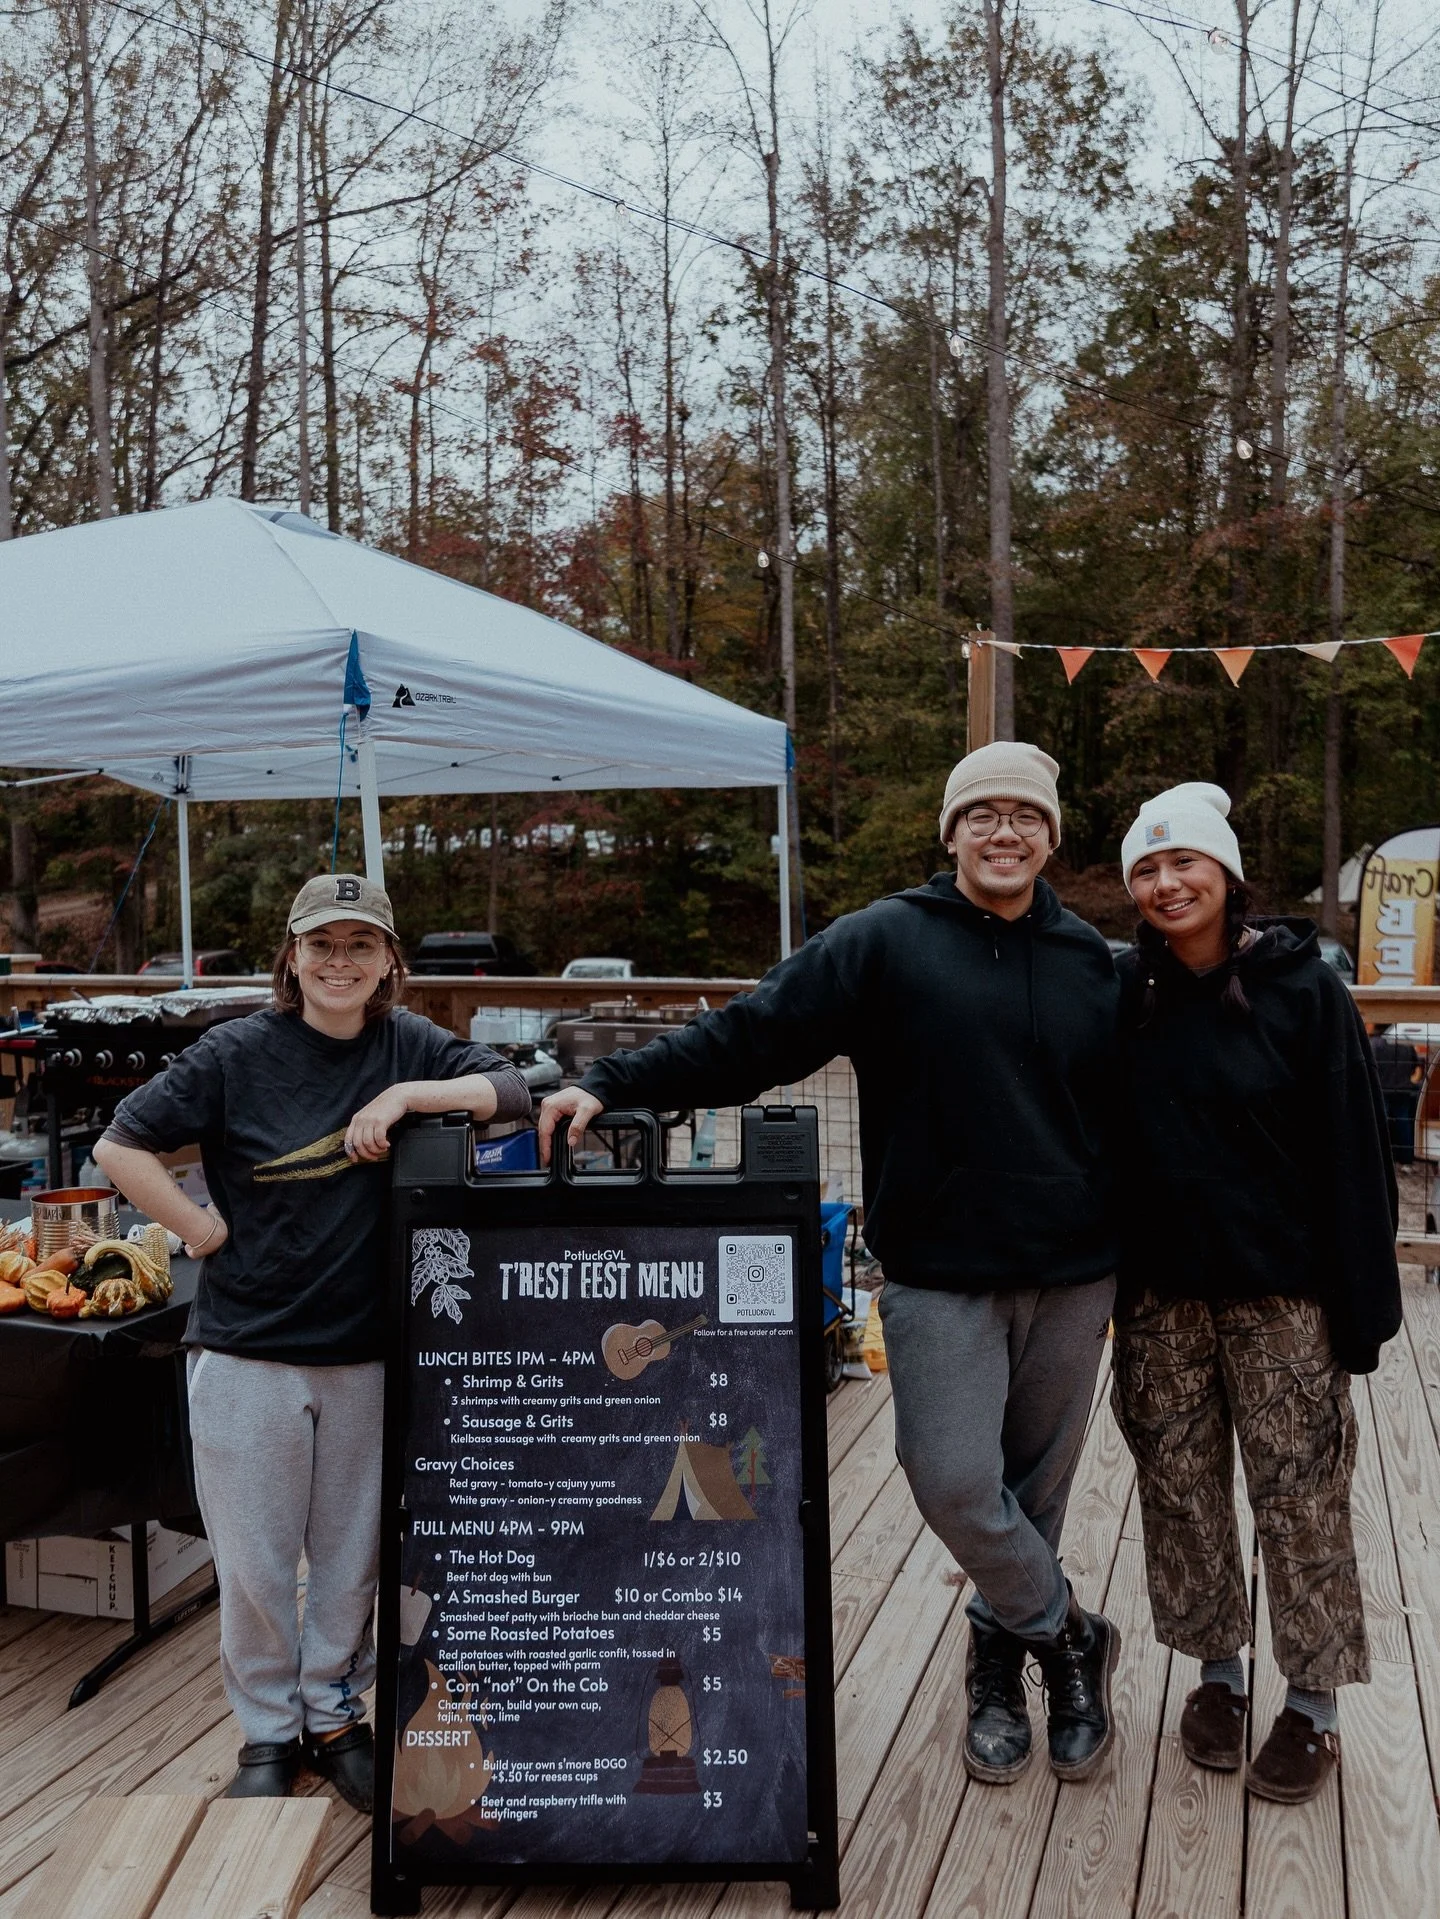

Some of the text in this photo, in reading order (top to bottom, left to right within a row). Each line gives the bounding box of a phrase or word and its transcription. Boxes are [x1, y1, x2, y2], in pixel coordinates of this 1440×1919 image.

[334, 878, 362, 902] B
[565, 1250, 625, 1260] PotluckGVL
[581, 1262, 630, 1299] FEST
[639, 1262, 703, 1299] MENU
[737, 1309, 776, 1317] POTLUCKGVL
[419, 1352, 467, 1365] LUNCH
[473, 1352, 511, 1365] BITES
[562, 1351, 595, 1364] 4PM
[463, 1375, 563, 1391] Shrimp & Grits
[710, 1372, 727, 1388] $8
[452, 1395, 660, 1408] 3 shrimps with creamy grits and green onion
[463, 1415, 573, 1431] Sausage & Grits
[710, 1412, 727, 1428] $8
[451, 1433, 700, 1445] Kielbasa sausage with creamy grits and green onion
[415, 1457, 514, 1474] Gravy Choices
[450, 1479, 468, 1487] Red
[471, 1481, 497, 1490] gravy
[509, 1479, 554, 1490] tomato-y
[557, 1479, 588, 1490] cajuny
[591, 1481, 615, 1490] yums
[449, 1495, 477, 1504] White
[480, 1498, 507, 1507] gravy
[518, 1496, 556, 1507] onion-y
[558, 1498, 593, 1507] creamy
[596, 1495, 641, 1506] goodness
[414, 1521, 446, 1535] FULL
[450, 1521, 494, 1535] MENU
[499, 1521, 532, 1535] 4PM
[551, 1521, 584, 1535] 9PM
[450, 1550, 534, 1567] The Hot Dog
[680, 1557, 694, 1565] or
[699, 1551, 740, 1567] 2/$10
[109, 1545, 118, 1611] KETCHUP
[447, 1572, 551, 1584] Beef hot dog with bun
[448, 1590, 579, 1607] A Smashed Burger
[615, 1586, 742, 1604] $10 or Combo $14
[440, 1610, 720, 1624] Smashed beef patty with brioche bun and cheddar cheese
[448, 1627, 614, 1640] Some Roasted Potatoes
[703, 1626, 721, 1643] $5
[439, 1648, 675, 1662] Red potatoes with roasted garlic confit, tossed in
[439, 1660, 600, 1672] scallion butter, topped with parm
[446, 1679, 479, 1692] Corn
[527, 1678, 548, 1692] On
[553, 1678, 575, 1692] the
[580, 1678, 608, 1692] Cob
[703, 1675, 721, 1692] $5
[438, 1700, 477, 1710] Charred
[480, 1703, 504, 1712] corn,
[507, 1700, 531, 1710] build
[535, 1703, 556, 1712] your
[581, 1703, 601, 1712] cup,
[438, 1711, 520, 1725] tajin, mayo, lime
[407, 1731, 471, 1746] DESSERT
[704, 1748, 747, 1766] $2.50
[483, 1759, 508, 1771] Build
[510, 1762, 534, 1773] your
[558, 1758, 591, 1769] s'more
[595, 1759, 626, 1769] BOGO
[491, 1770, 522, 1783] +$.50
[525, 1771, 539, 1782] for
[575, 1774, 598, 1784] cups
[506, 1795, 526, 1806] and
[529, 1795, 577, 1808] raspberry
[580, 1794, 603, 1805] trifle
[606, 1794, 626, 1804] with
[704, 1790, 722, 1809] $3
[481, 1808, 537, 1821] ladyfingers
